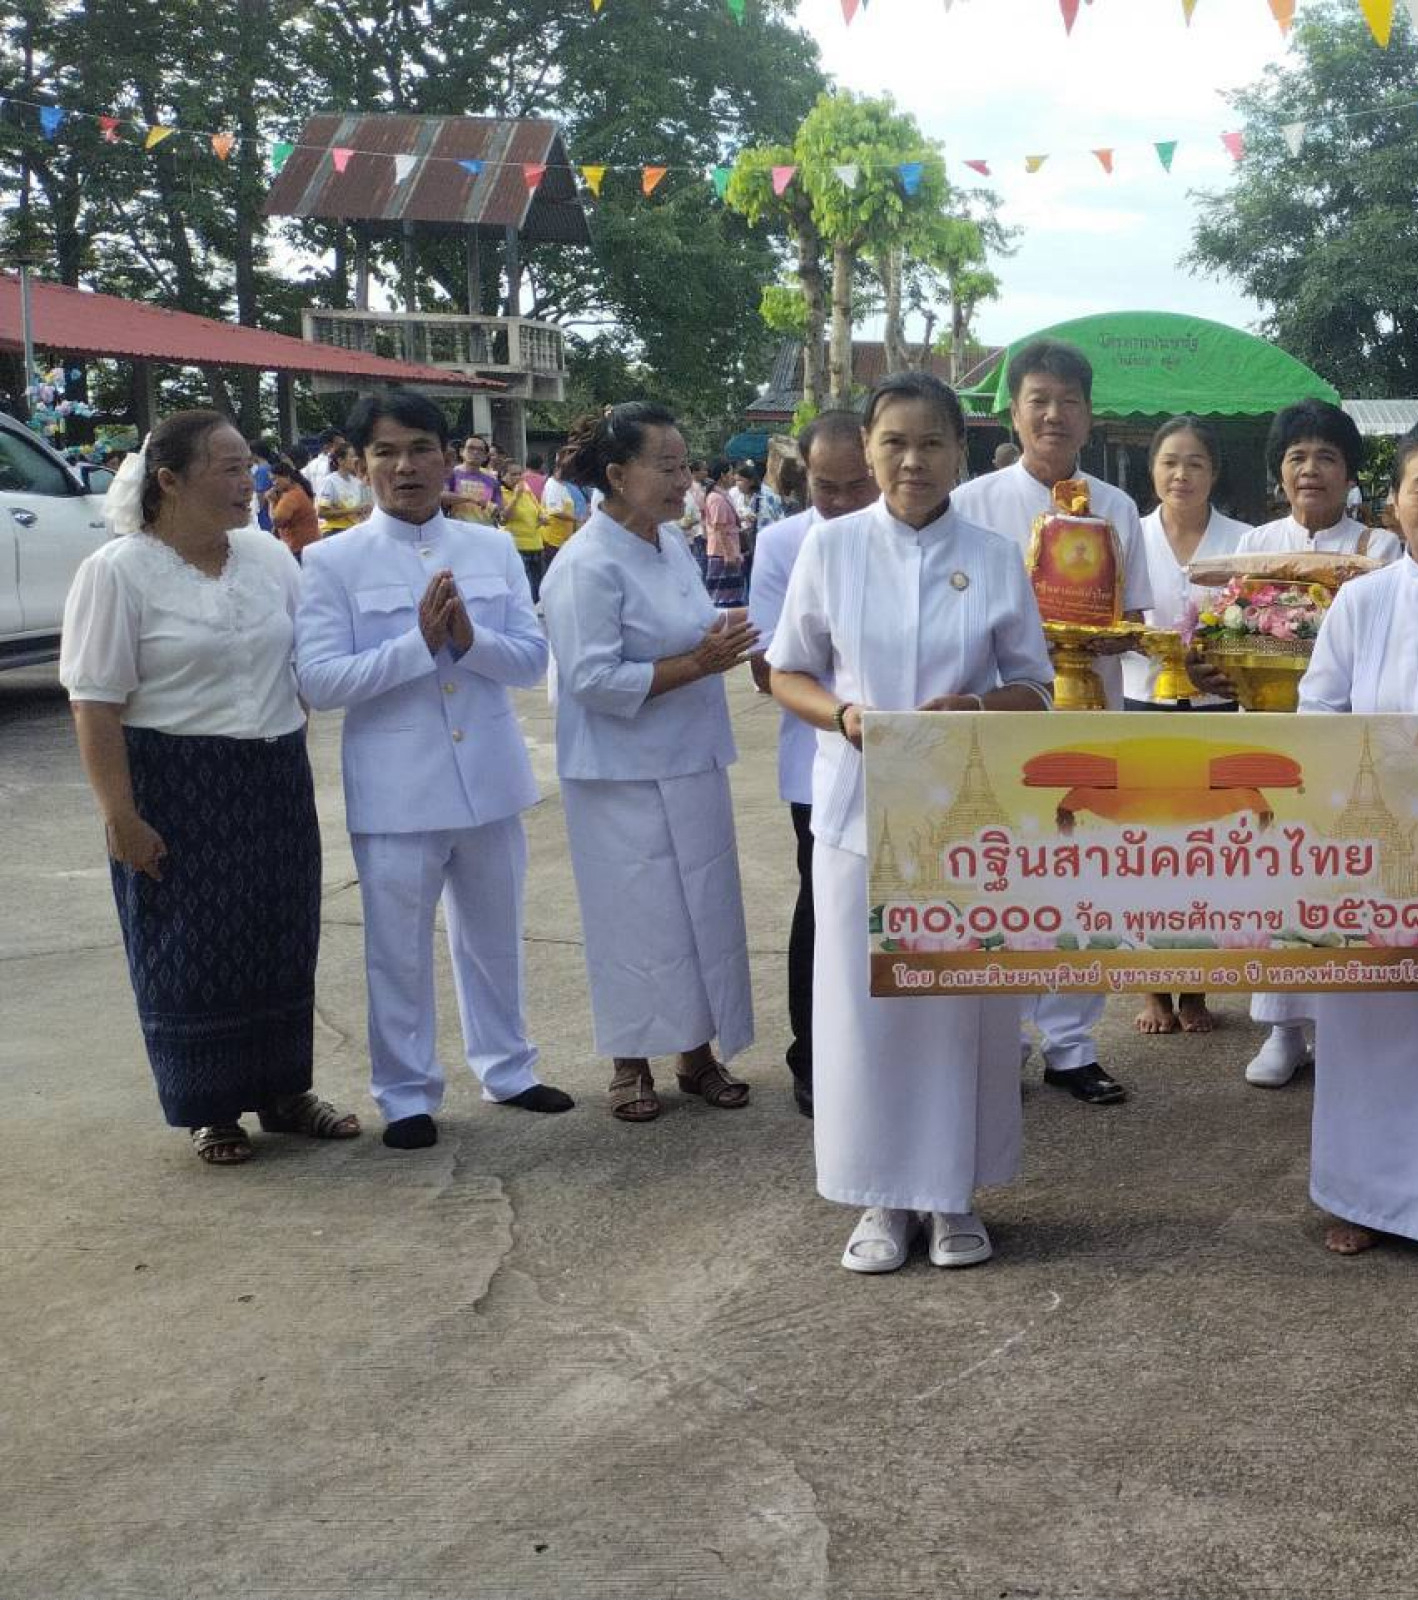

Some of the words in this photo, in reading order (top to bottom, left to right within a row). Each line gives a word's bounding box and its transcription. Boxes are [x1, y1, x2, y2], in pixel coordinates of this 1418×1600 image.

[948, 816, 1374, 892] กฐินสามัคคีทั่วไทย
[887, 904, 1062, 939] ๓๐,๐๐๐
[1075, 900, 1113, 932] วัด
[1122, 900, 1284, 941] พุทธศักราช
[894, 964, 933, 987] โดย
[1246, 961, 1261, 984] ปี
